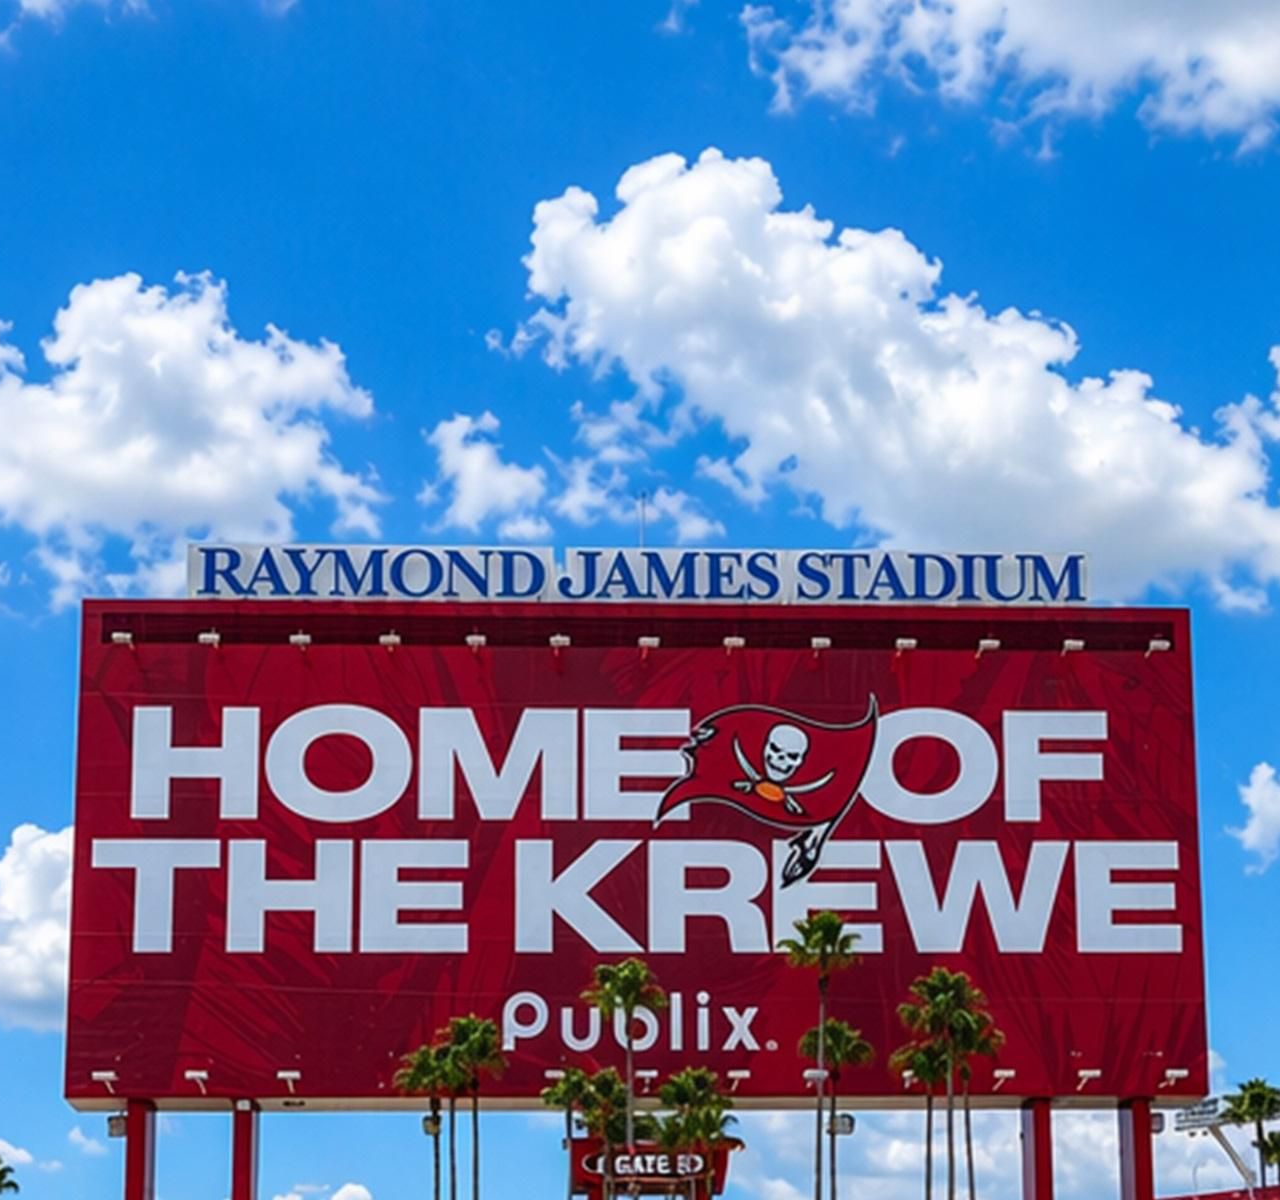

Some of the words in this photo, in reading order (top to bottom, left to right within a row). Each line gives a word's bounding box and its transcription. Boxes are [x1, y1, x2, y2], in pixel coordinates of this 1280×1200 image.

[197, 546, 544, 599] RAYMOND
[558, 549, 782, 600] JAMES
[795, 552, 1087, 601] STADIUM
[130, 703, 692, 823] HOME
[858, 706, 1109, 824] OF
[91, 838, 470, 953] THE
[514, 838, 1184, 953] KREWE
[614, 1154, 672, 1175] GATE
